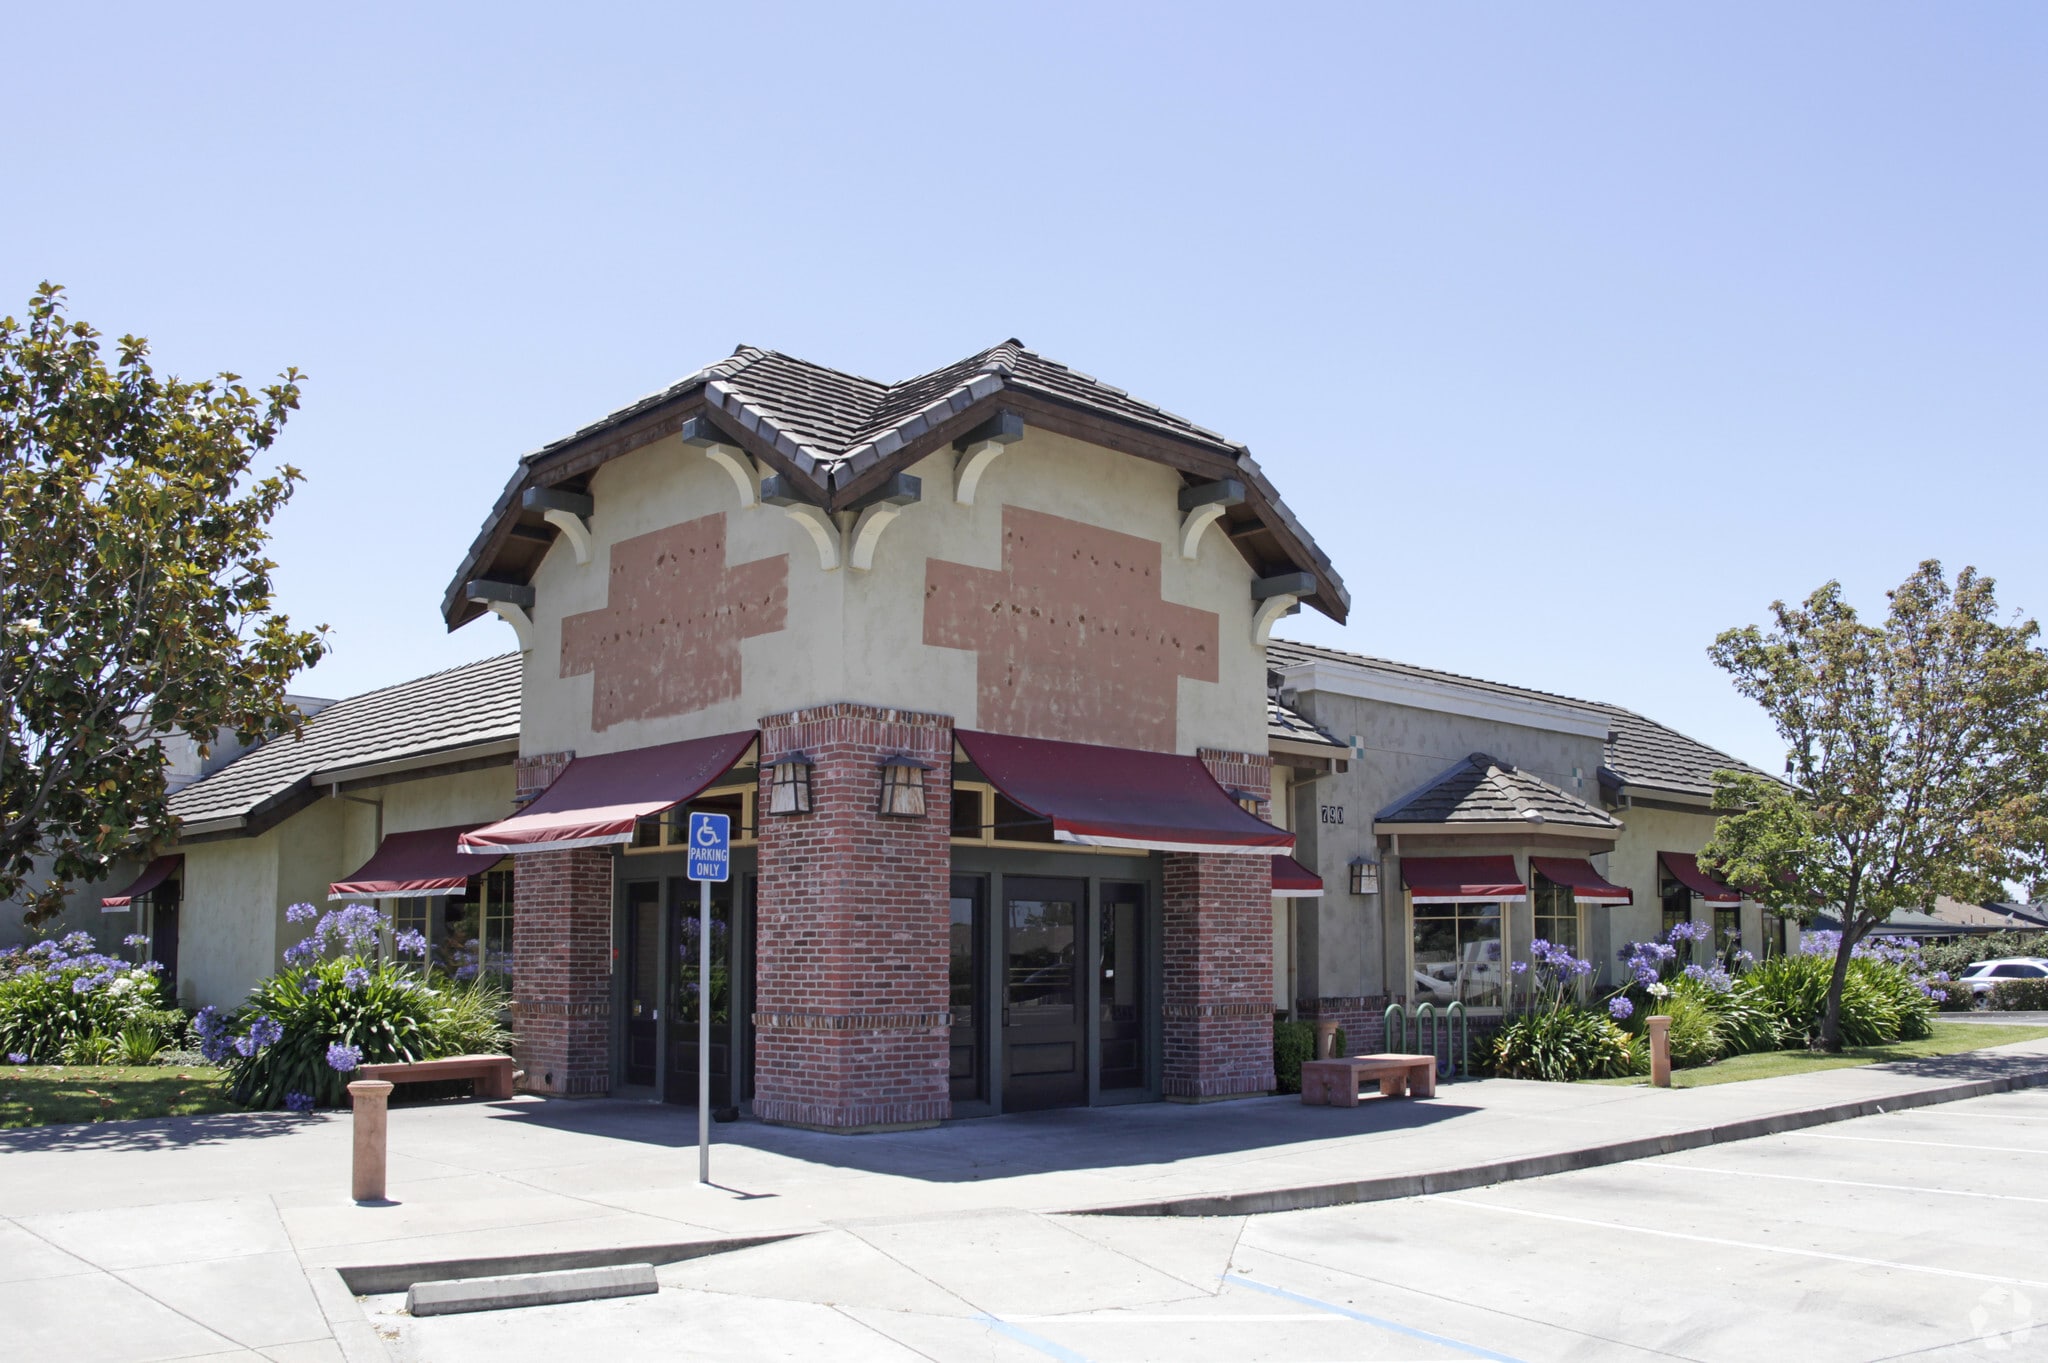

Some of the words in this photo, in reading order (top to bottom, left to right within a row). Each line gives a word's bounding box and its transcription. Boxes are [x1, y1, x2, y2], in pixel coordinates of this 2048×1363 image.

[1322, 806, 1343, 823] 790
[690, 847, 727, 861] PARKING
[697, 863, 719, 876] ONLY
